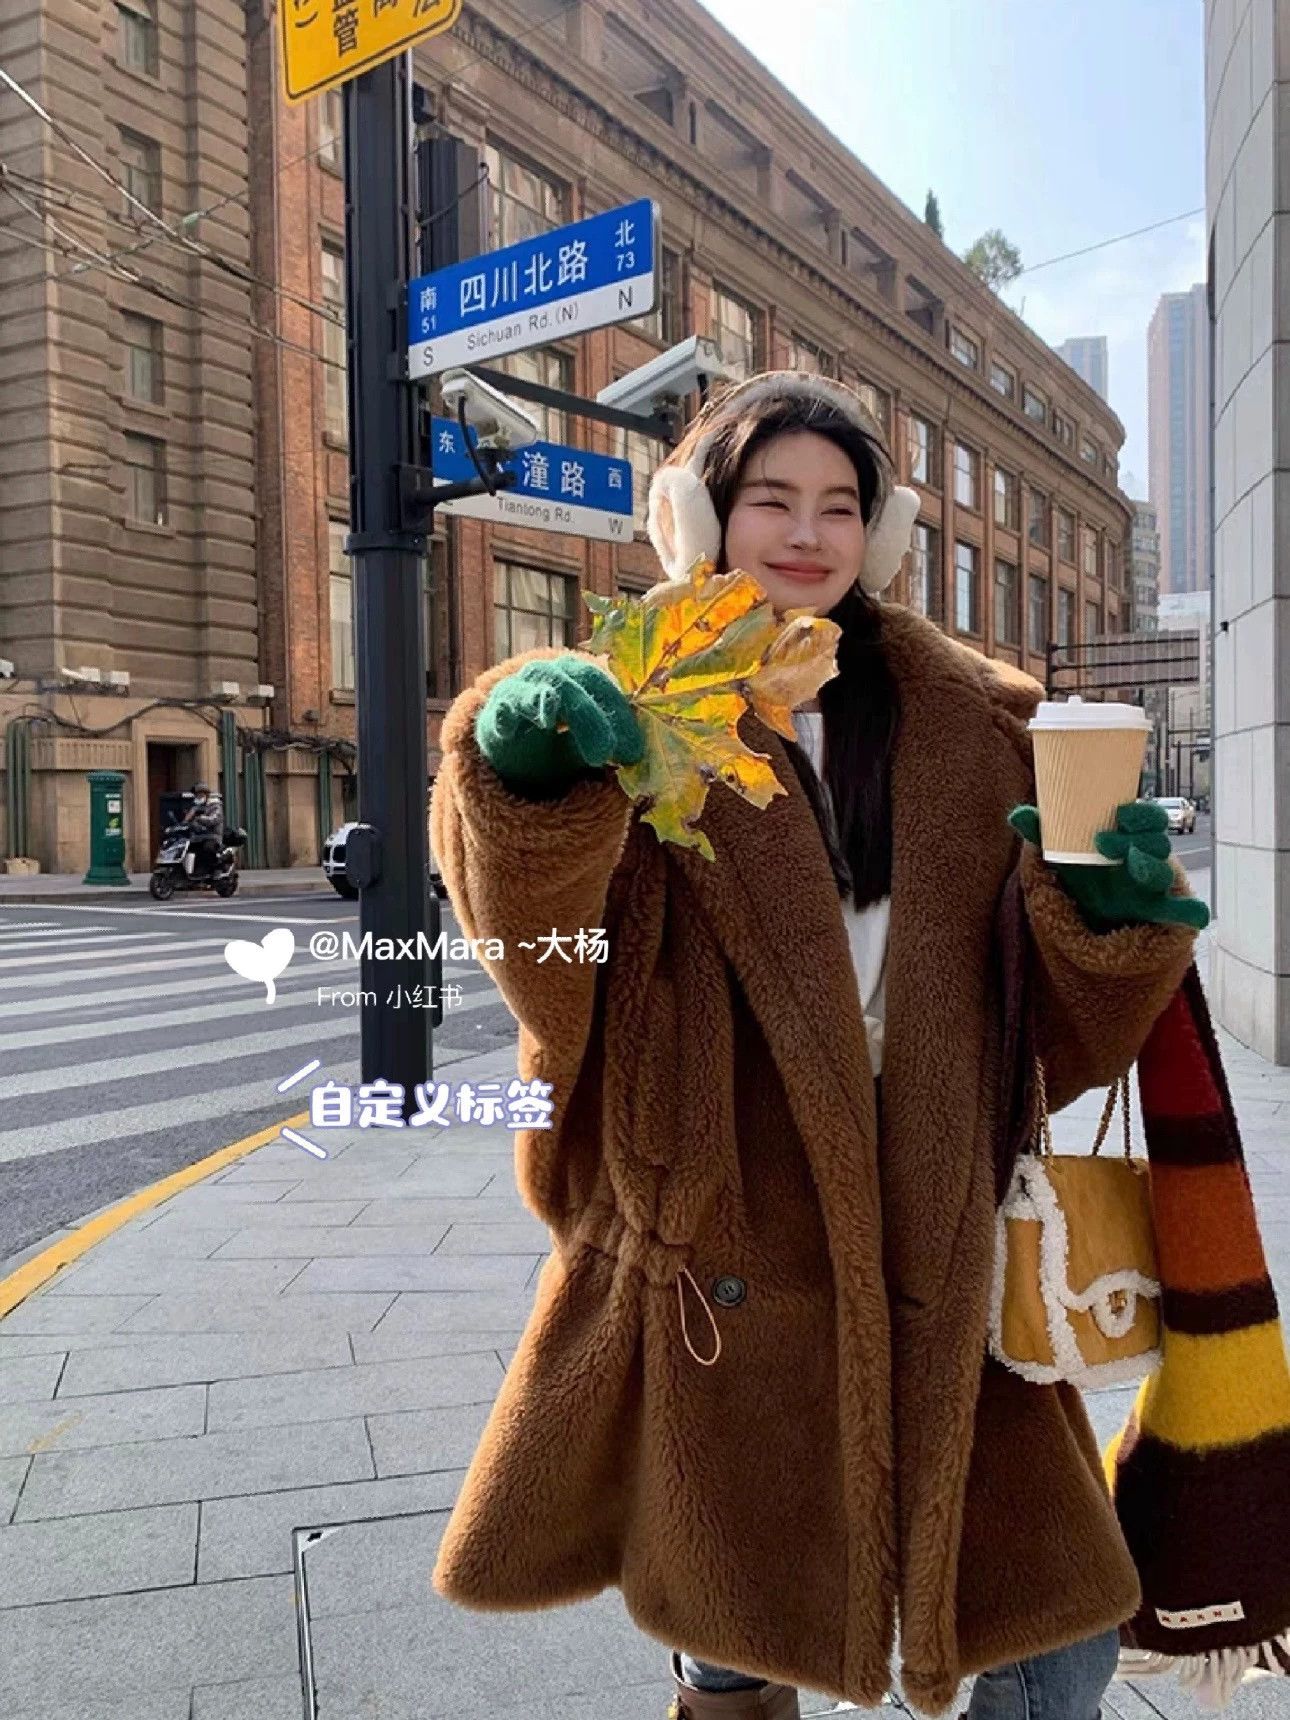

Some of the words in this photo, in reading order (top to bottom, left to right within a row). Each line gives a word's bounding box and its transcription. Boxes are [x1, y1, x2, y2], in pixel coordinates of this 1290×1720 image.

[614, 219, 635, 248] 北
[616, 251, 635, 272] 73
[460, 239, 588, 317] 四川北路
[420, 286, 437, 313] 南
[618, 285, 633, 310] N
[421, 316, 437, 334] 51
[466, 321, 522, 351] Sichuan
[423, 346, 434, 367] S
[439, 430, 456, 454] 东
[496, 450, 586, 499] 潼路
[608, 467, 622, 490] 西
[609, 517, 624, 534] W
